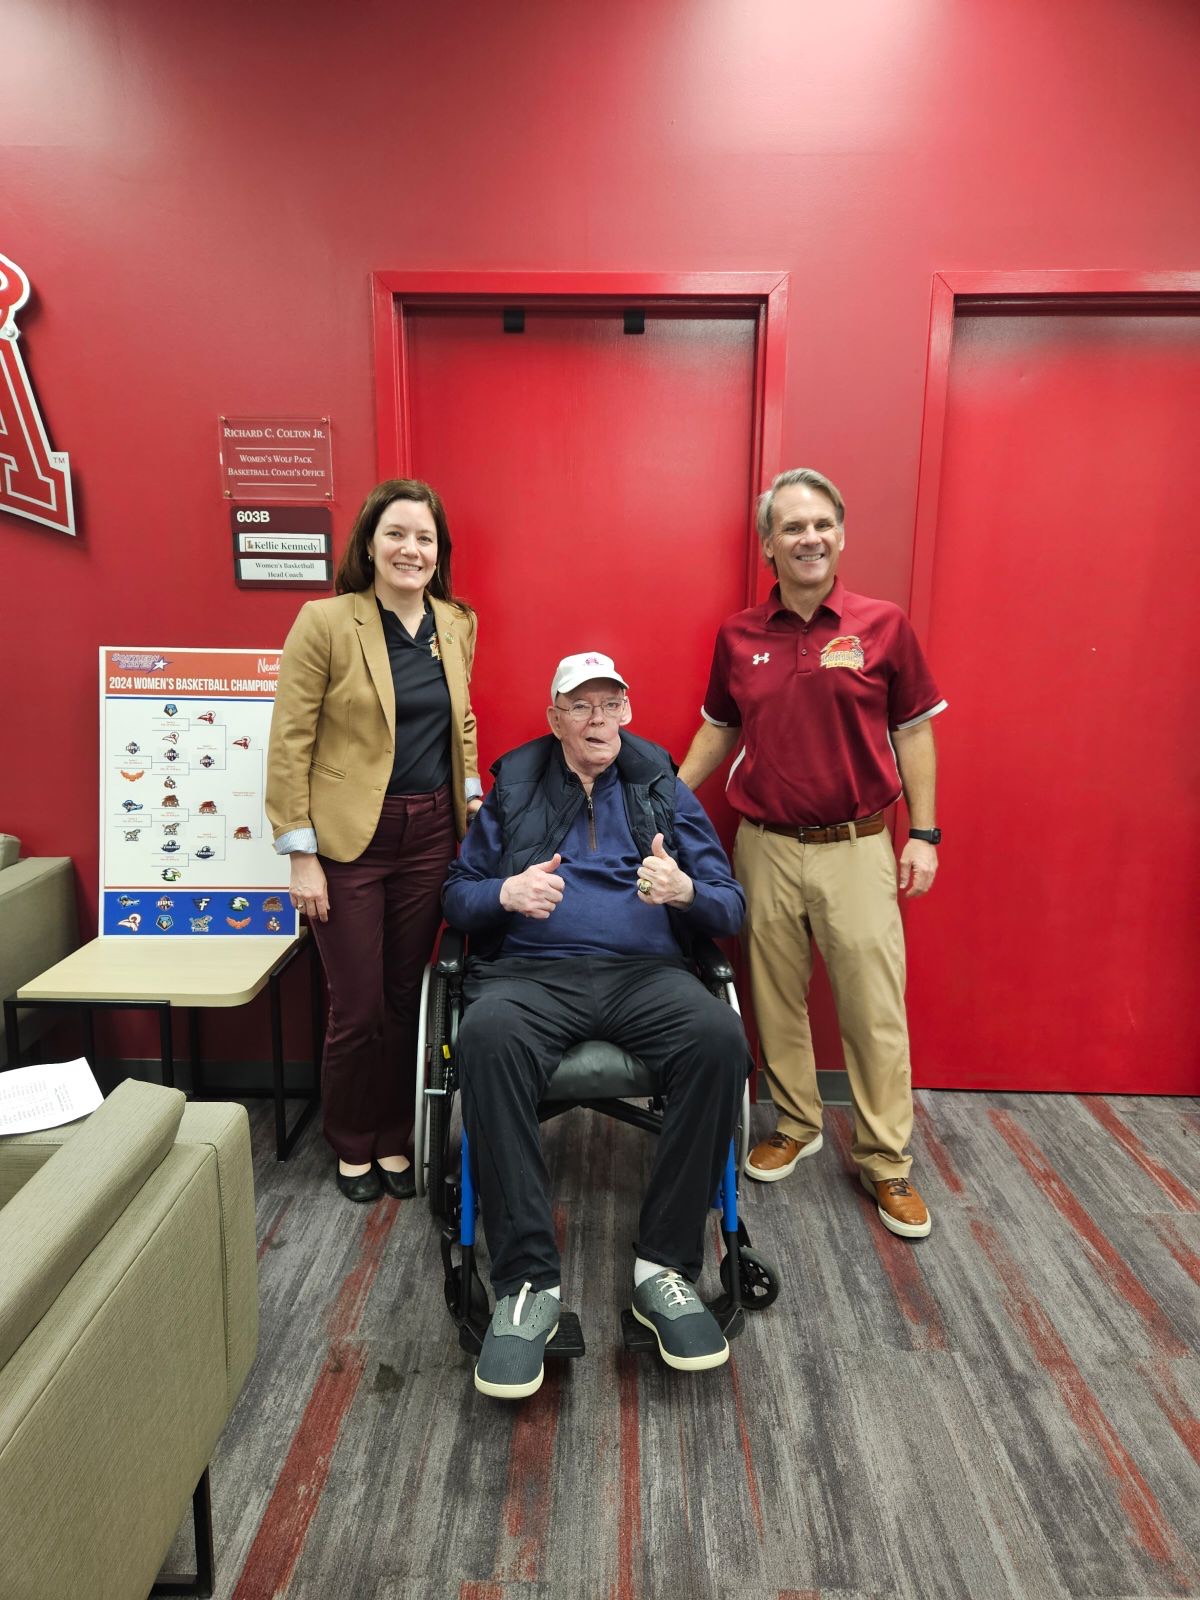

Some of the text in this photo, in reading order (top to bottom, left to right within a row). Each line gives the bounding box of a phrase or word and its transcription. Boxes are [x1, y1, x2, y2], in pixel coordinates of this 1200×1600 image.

[224, 428, 263, 438] RICHARD
[265, 428, 275, 439] C.
[276, 428, 311, 438] COLTON
[53, 456, 65, 464] TM
[239, 454, 312, 464] WOMEN'S WOLF PACK
[228, 467, 325, 477] BASKETBALL COACH'S OFFICE
[236, 510, 270, 523] 603B
[254, 541, 279, 550] Kellie
[281, 542, 318, 553] Kennedy
[109, 676, 132, 689] 2024
[134, 677, 175, 690] WOMEN'S
[176, 678, 230, 691] BASKETBALL
